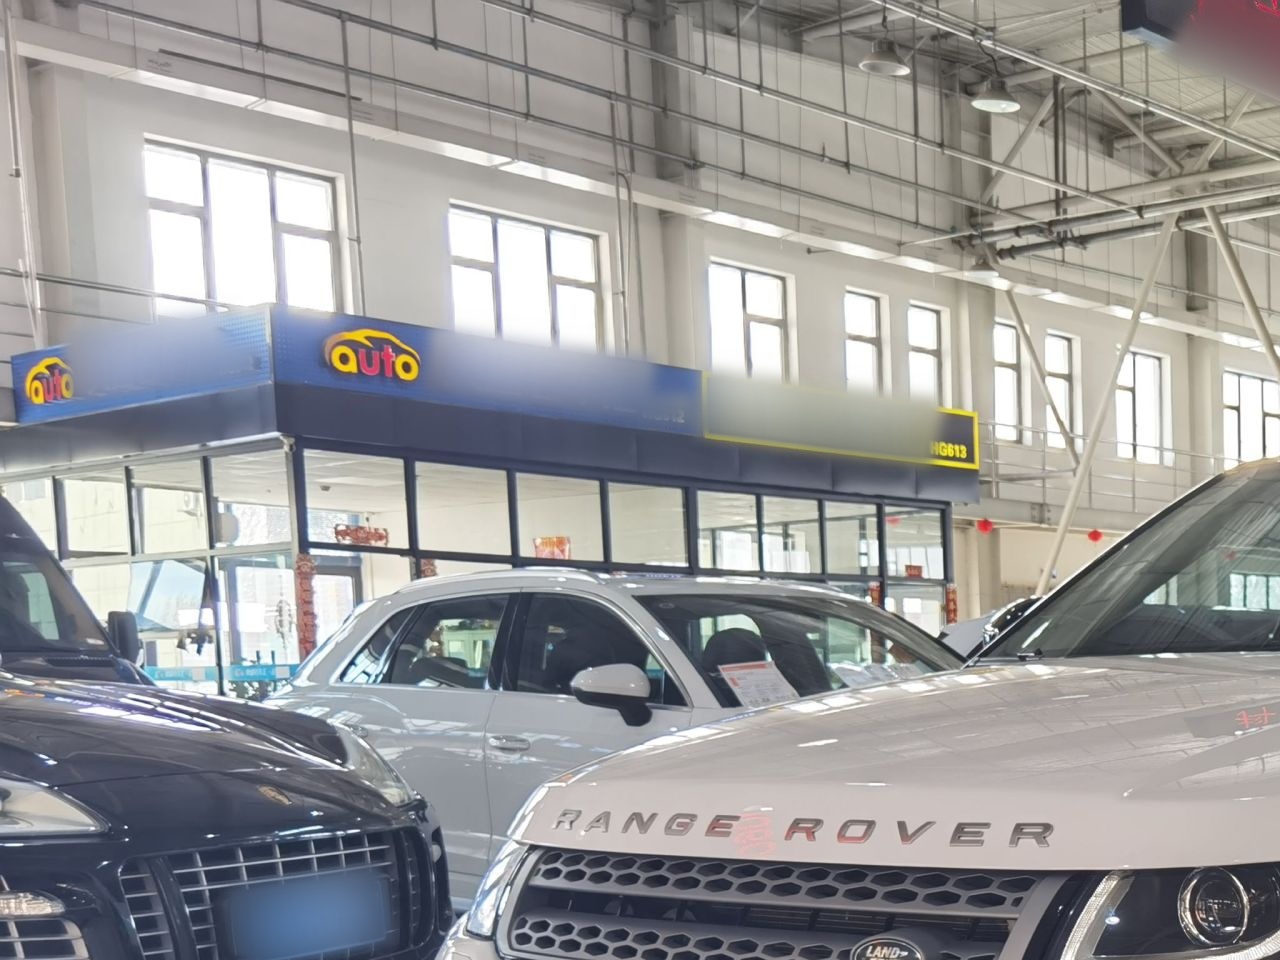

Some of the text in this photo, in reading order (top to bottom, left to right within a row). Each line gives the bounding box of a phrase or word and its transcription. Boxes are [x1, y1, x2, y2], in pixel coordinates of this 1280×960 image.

[331, 345, 421, 382] auto
[550, 808, 741, 838] RANGE
[785, 817, 1055, 848] ROVER
[866, 945, 900, 959] LAND
